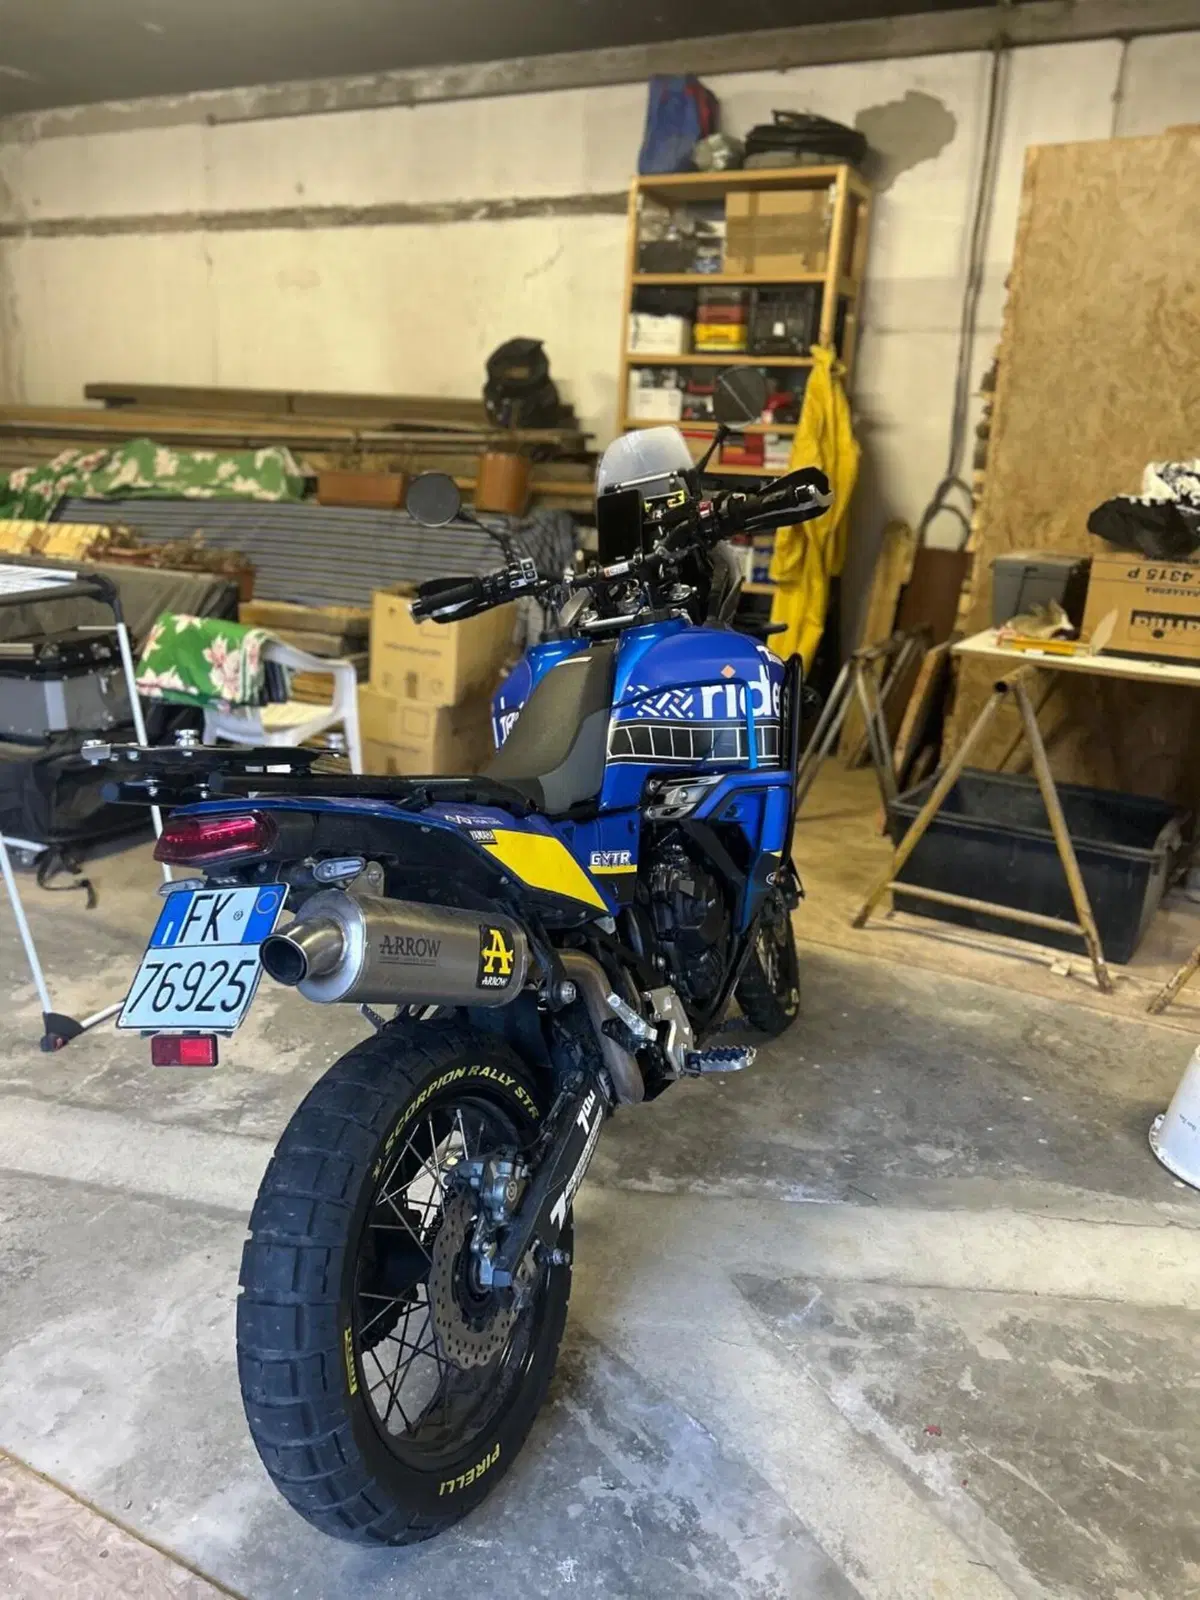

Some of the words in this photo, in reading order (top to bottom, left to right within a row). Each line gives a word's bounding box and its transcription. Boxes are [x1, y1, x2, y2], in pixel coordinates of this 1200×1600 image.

[1127, 567, 1141, 580] P
[1145, 568, 1195, 583] 4315
[591, 850, 632, 866] GYTR
[179, 893, 236, 943] FK
[379, 935, 441, 958] ARROW
[128, 959, 257, 1013] 76925
[481, 975, 508, 987] ARROW
[384, 1066, 467, 1155] SCORPION
[467, 1065, 516, 1085] RALLY
[514, 1086, 541, 1120] STR
[439, 1443, 501, 1496] PIRELLI
